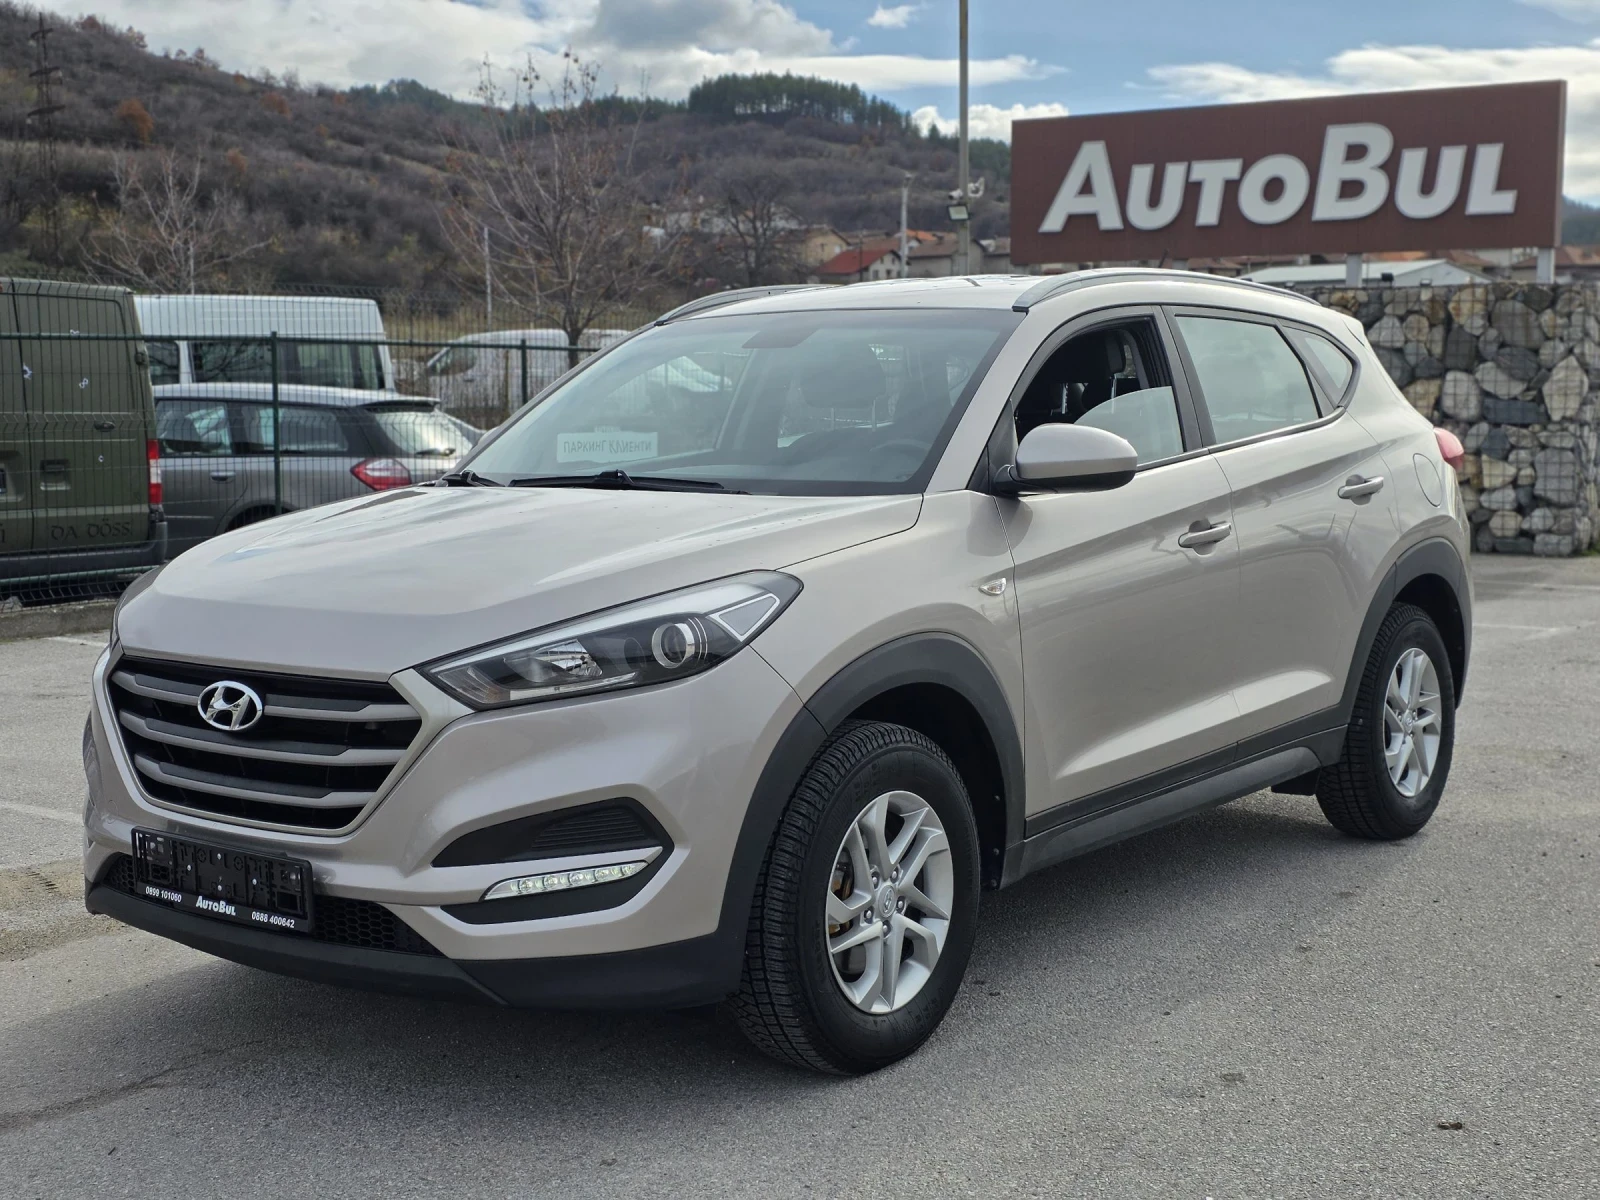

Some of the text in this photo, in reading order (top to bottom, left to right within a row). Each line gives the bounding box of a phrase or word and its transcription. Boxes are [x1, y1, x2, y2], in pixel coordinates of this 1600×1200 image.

[1038, 122, 1518, 234] AUTOBUL
[563, 440, 652, 454] ПАРКИНГ КЛИЕНТИ
[251, 911, 295, 928] 0888 400642
